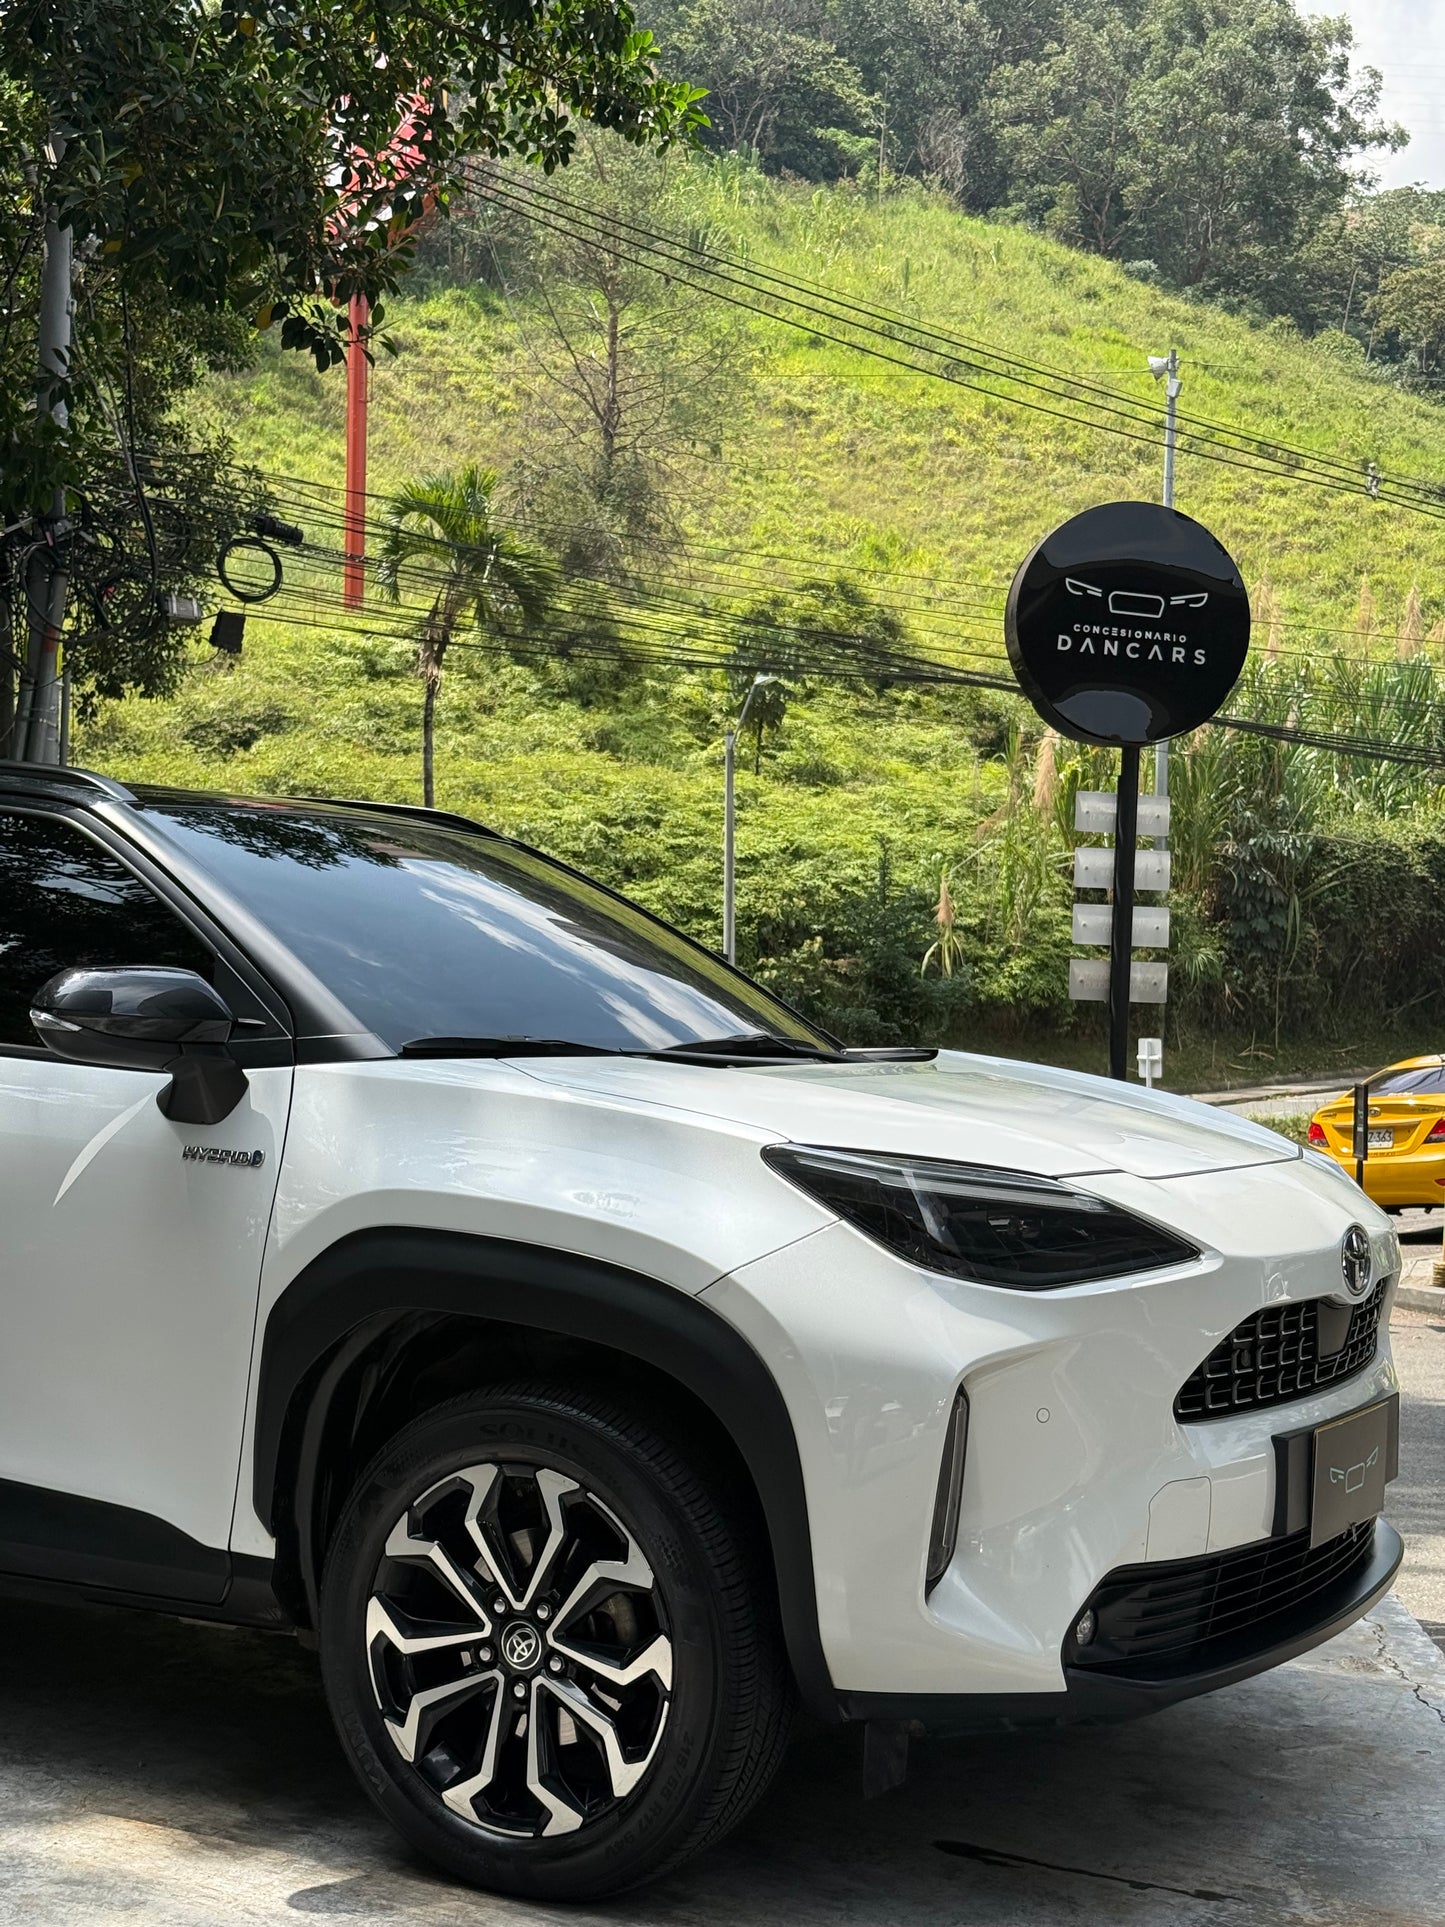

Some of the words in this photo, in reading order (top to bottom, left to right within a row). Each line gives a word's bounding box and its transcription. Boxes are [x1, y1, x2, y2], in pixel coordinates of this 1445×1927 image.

[1073, 623, 1187, 643] CONCESIONARIO
[1057, 634, 1207, 665] DANCARS
[182, 1145, 252, 1166] HYBRID
